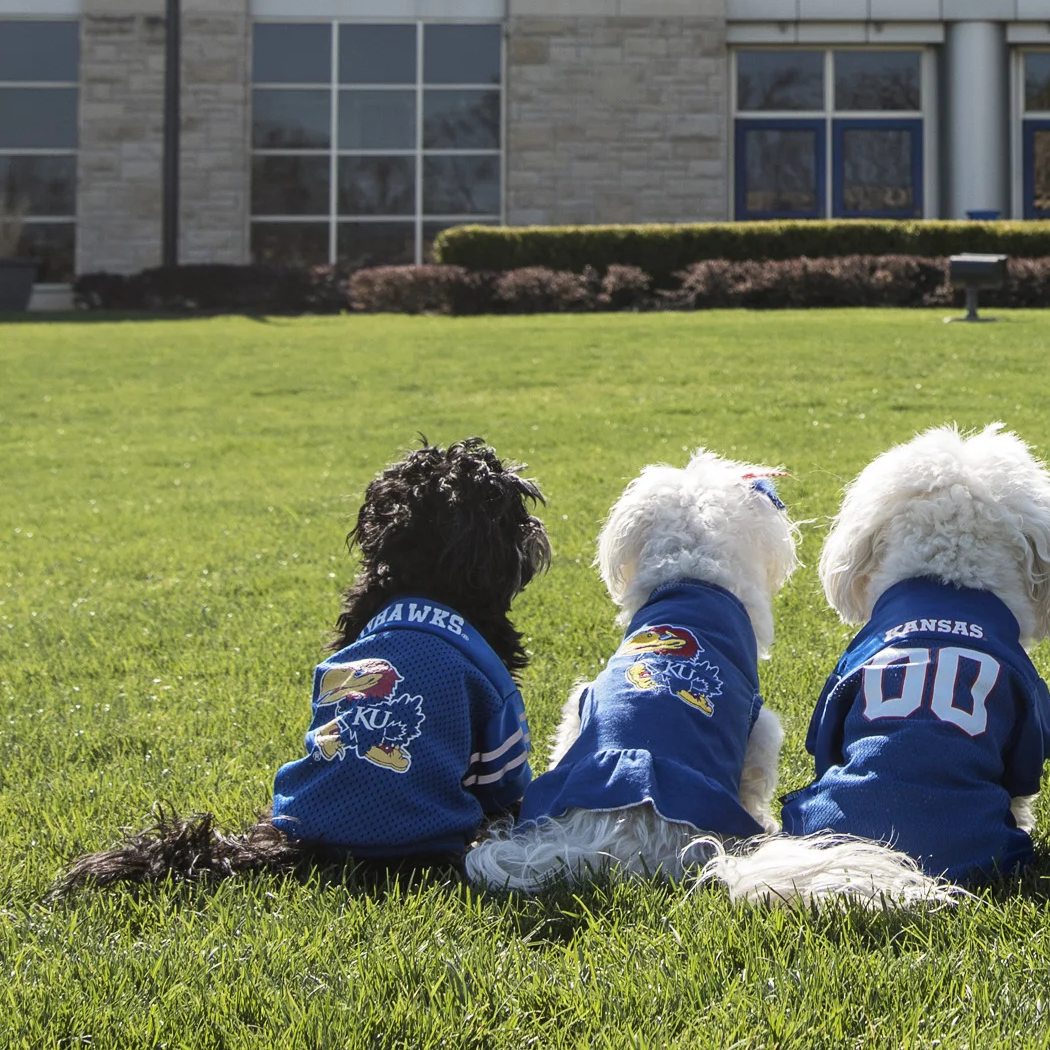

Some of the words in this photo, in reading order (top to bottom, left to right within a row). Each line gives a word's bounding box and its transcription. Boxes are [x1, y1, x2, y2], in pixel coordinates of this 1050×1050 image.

[884, 618, 984, 643] KANSAS
[662, 660, 697, 680] KU
[861, 646, 1001, 739] 00
[351, 706, 390, 730] KU
